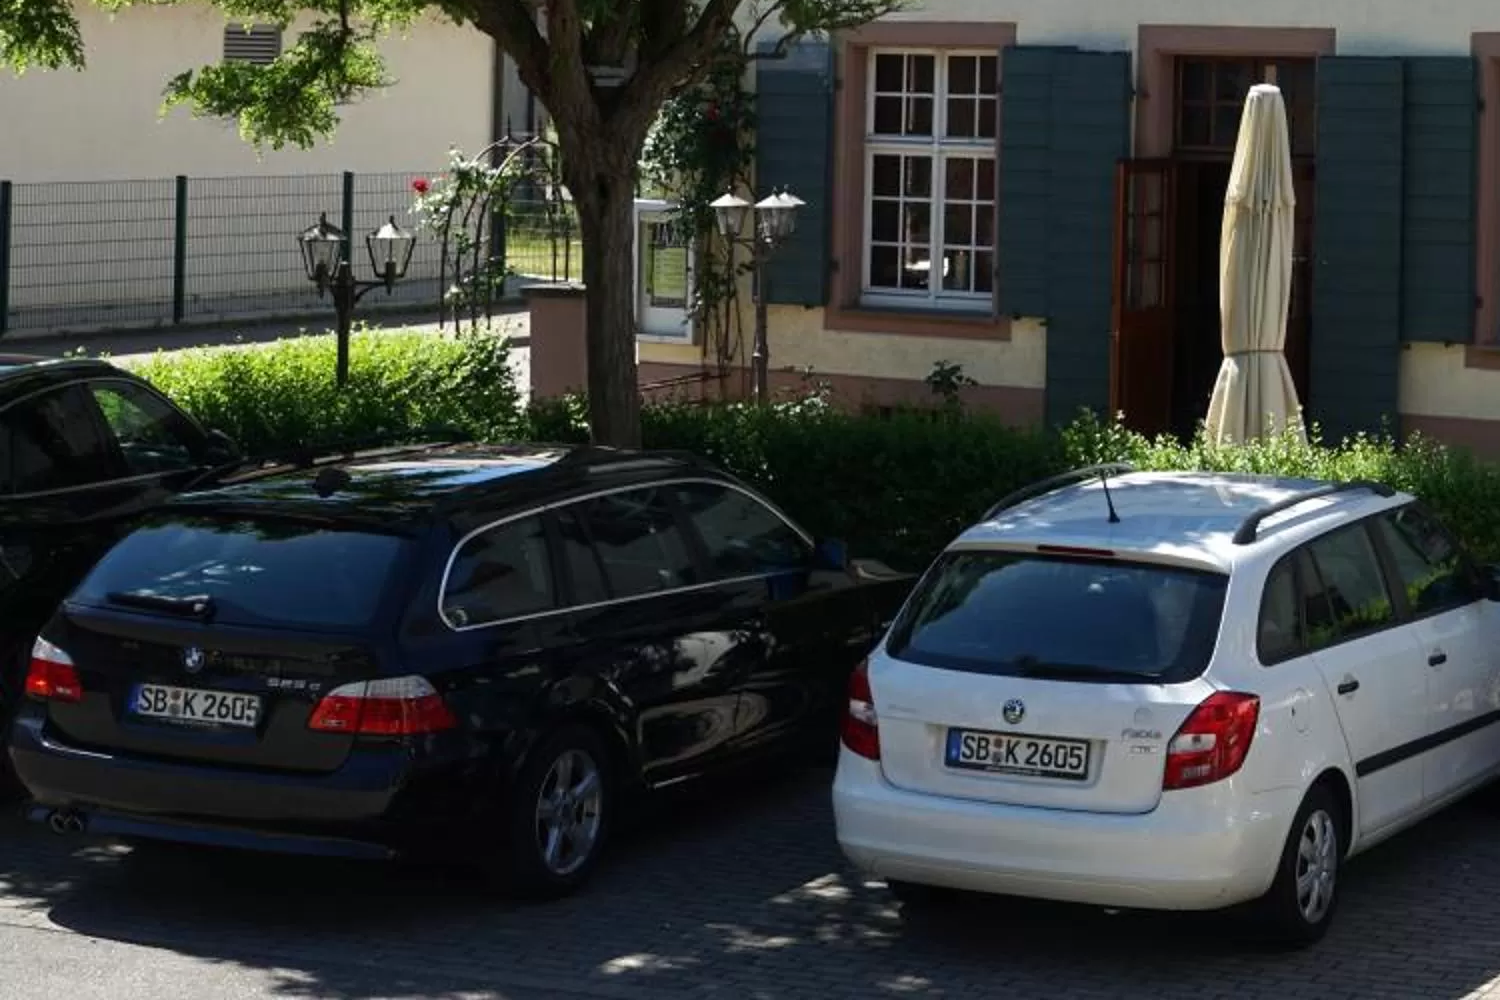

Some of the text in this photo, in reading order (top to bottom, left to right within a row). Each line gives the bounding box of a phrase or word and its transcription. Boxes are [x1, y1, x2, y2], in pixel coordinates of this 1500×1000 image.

[139, 687, 258, 723] SB K 2605
[961, 734, 1084, 771] SB K 2605
